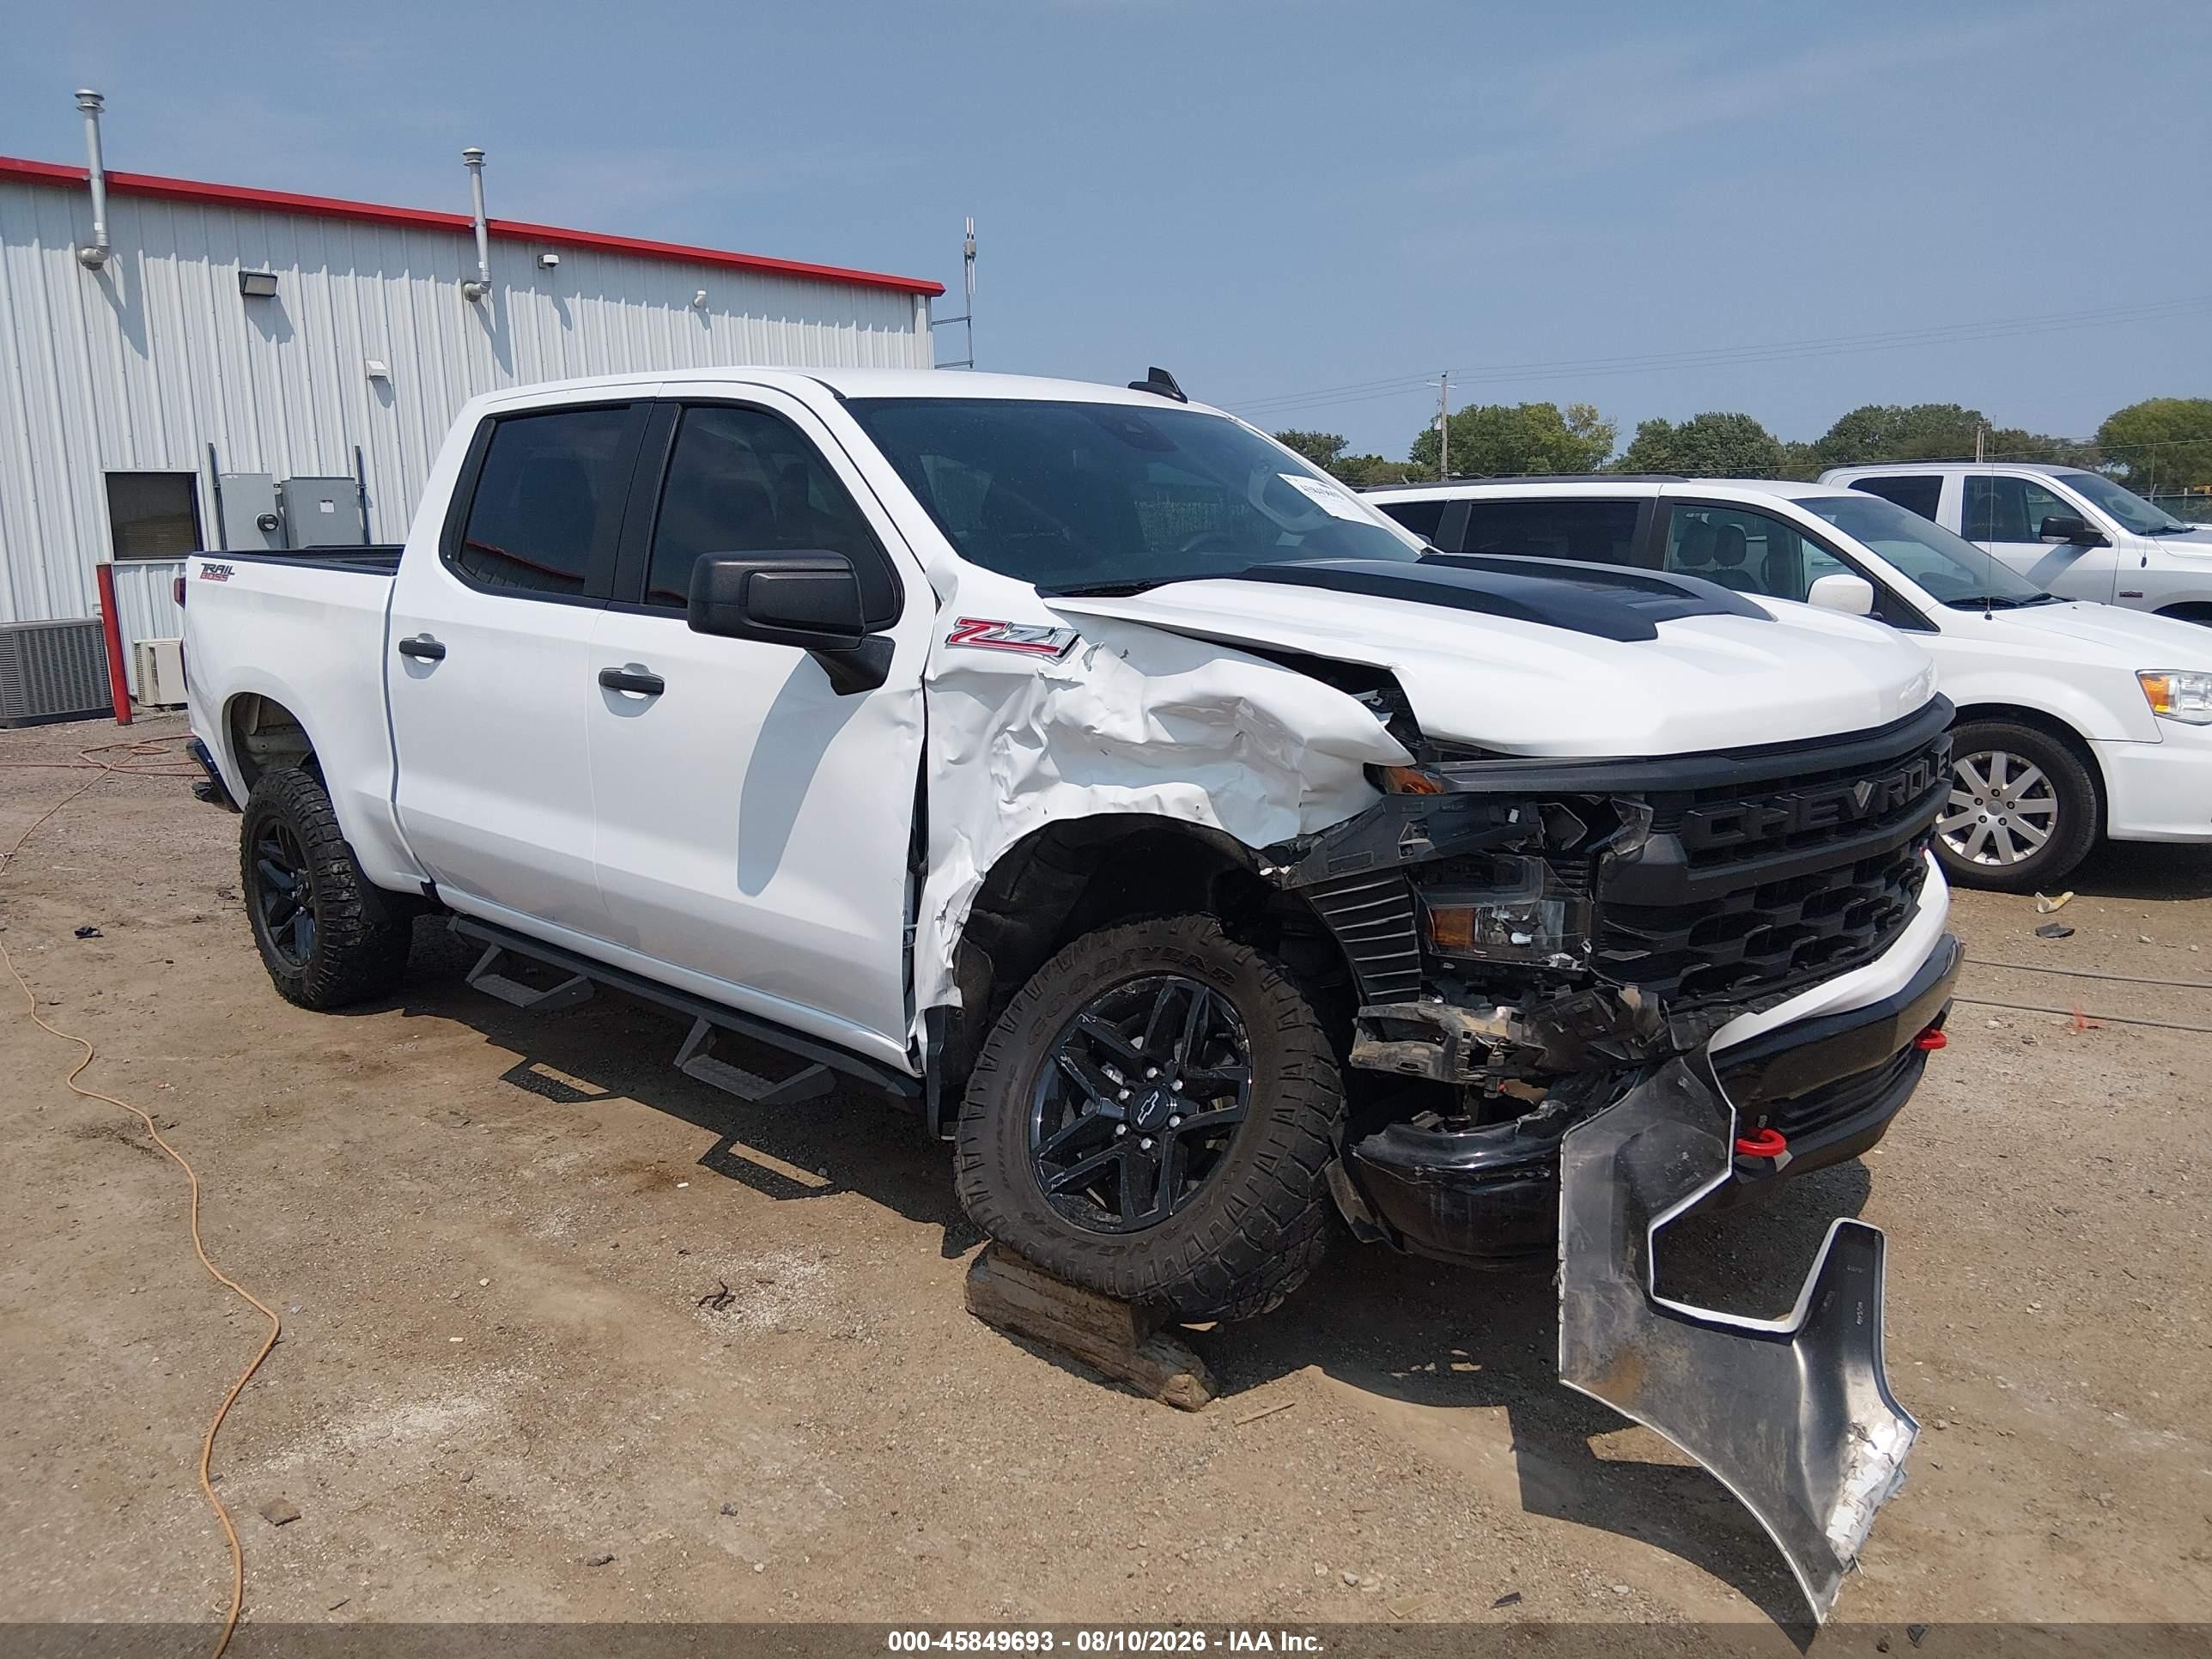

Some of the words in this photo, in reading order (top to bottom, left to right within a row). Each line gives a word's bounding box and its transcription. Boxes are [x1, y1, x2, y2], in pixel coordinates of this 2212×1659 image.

[199, 572, 229, 582] BOSS
[201, 562, 235, 575] TRAIL
[945, 617, 1080, 659] Z71
[1680, 733, 1954, 850] CHEVROLE
[1028, 945, 1237, 1046] GOODYEAR
